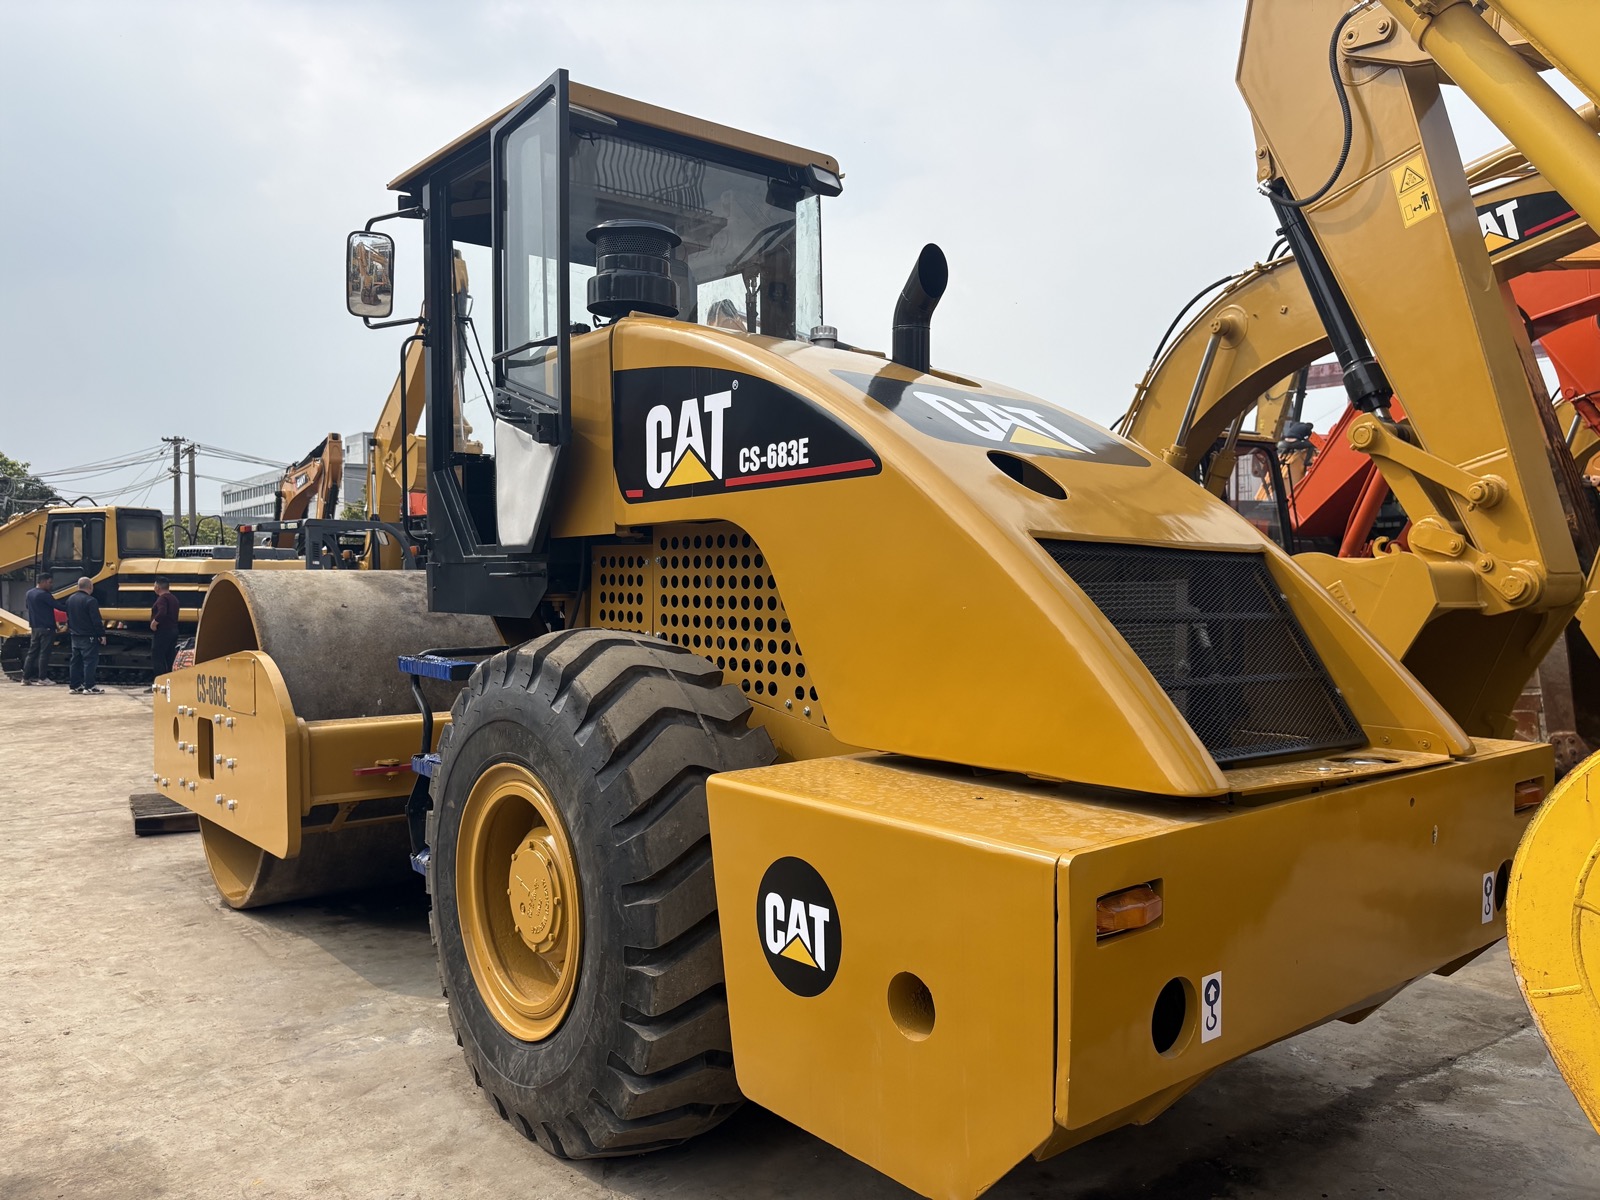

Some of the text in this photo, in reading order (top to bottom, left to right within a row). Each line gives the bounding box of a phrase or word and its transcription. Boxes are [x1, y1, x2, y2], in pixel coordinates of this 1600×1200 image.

[1478, 199, 1519, 240] AT
[646, 390, 732, 489] CAT
[912, 391, 1096, 454] CAT
[739, 437, 809, 473] CS-683E
[196, 673, 227, 708] CS-683E
[765, 892, 829, 971] CAT
